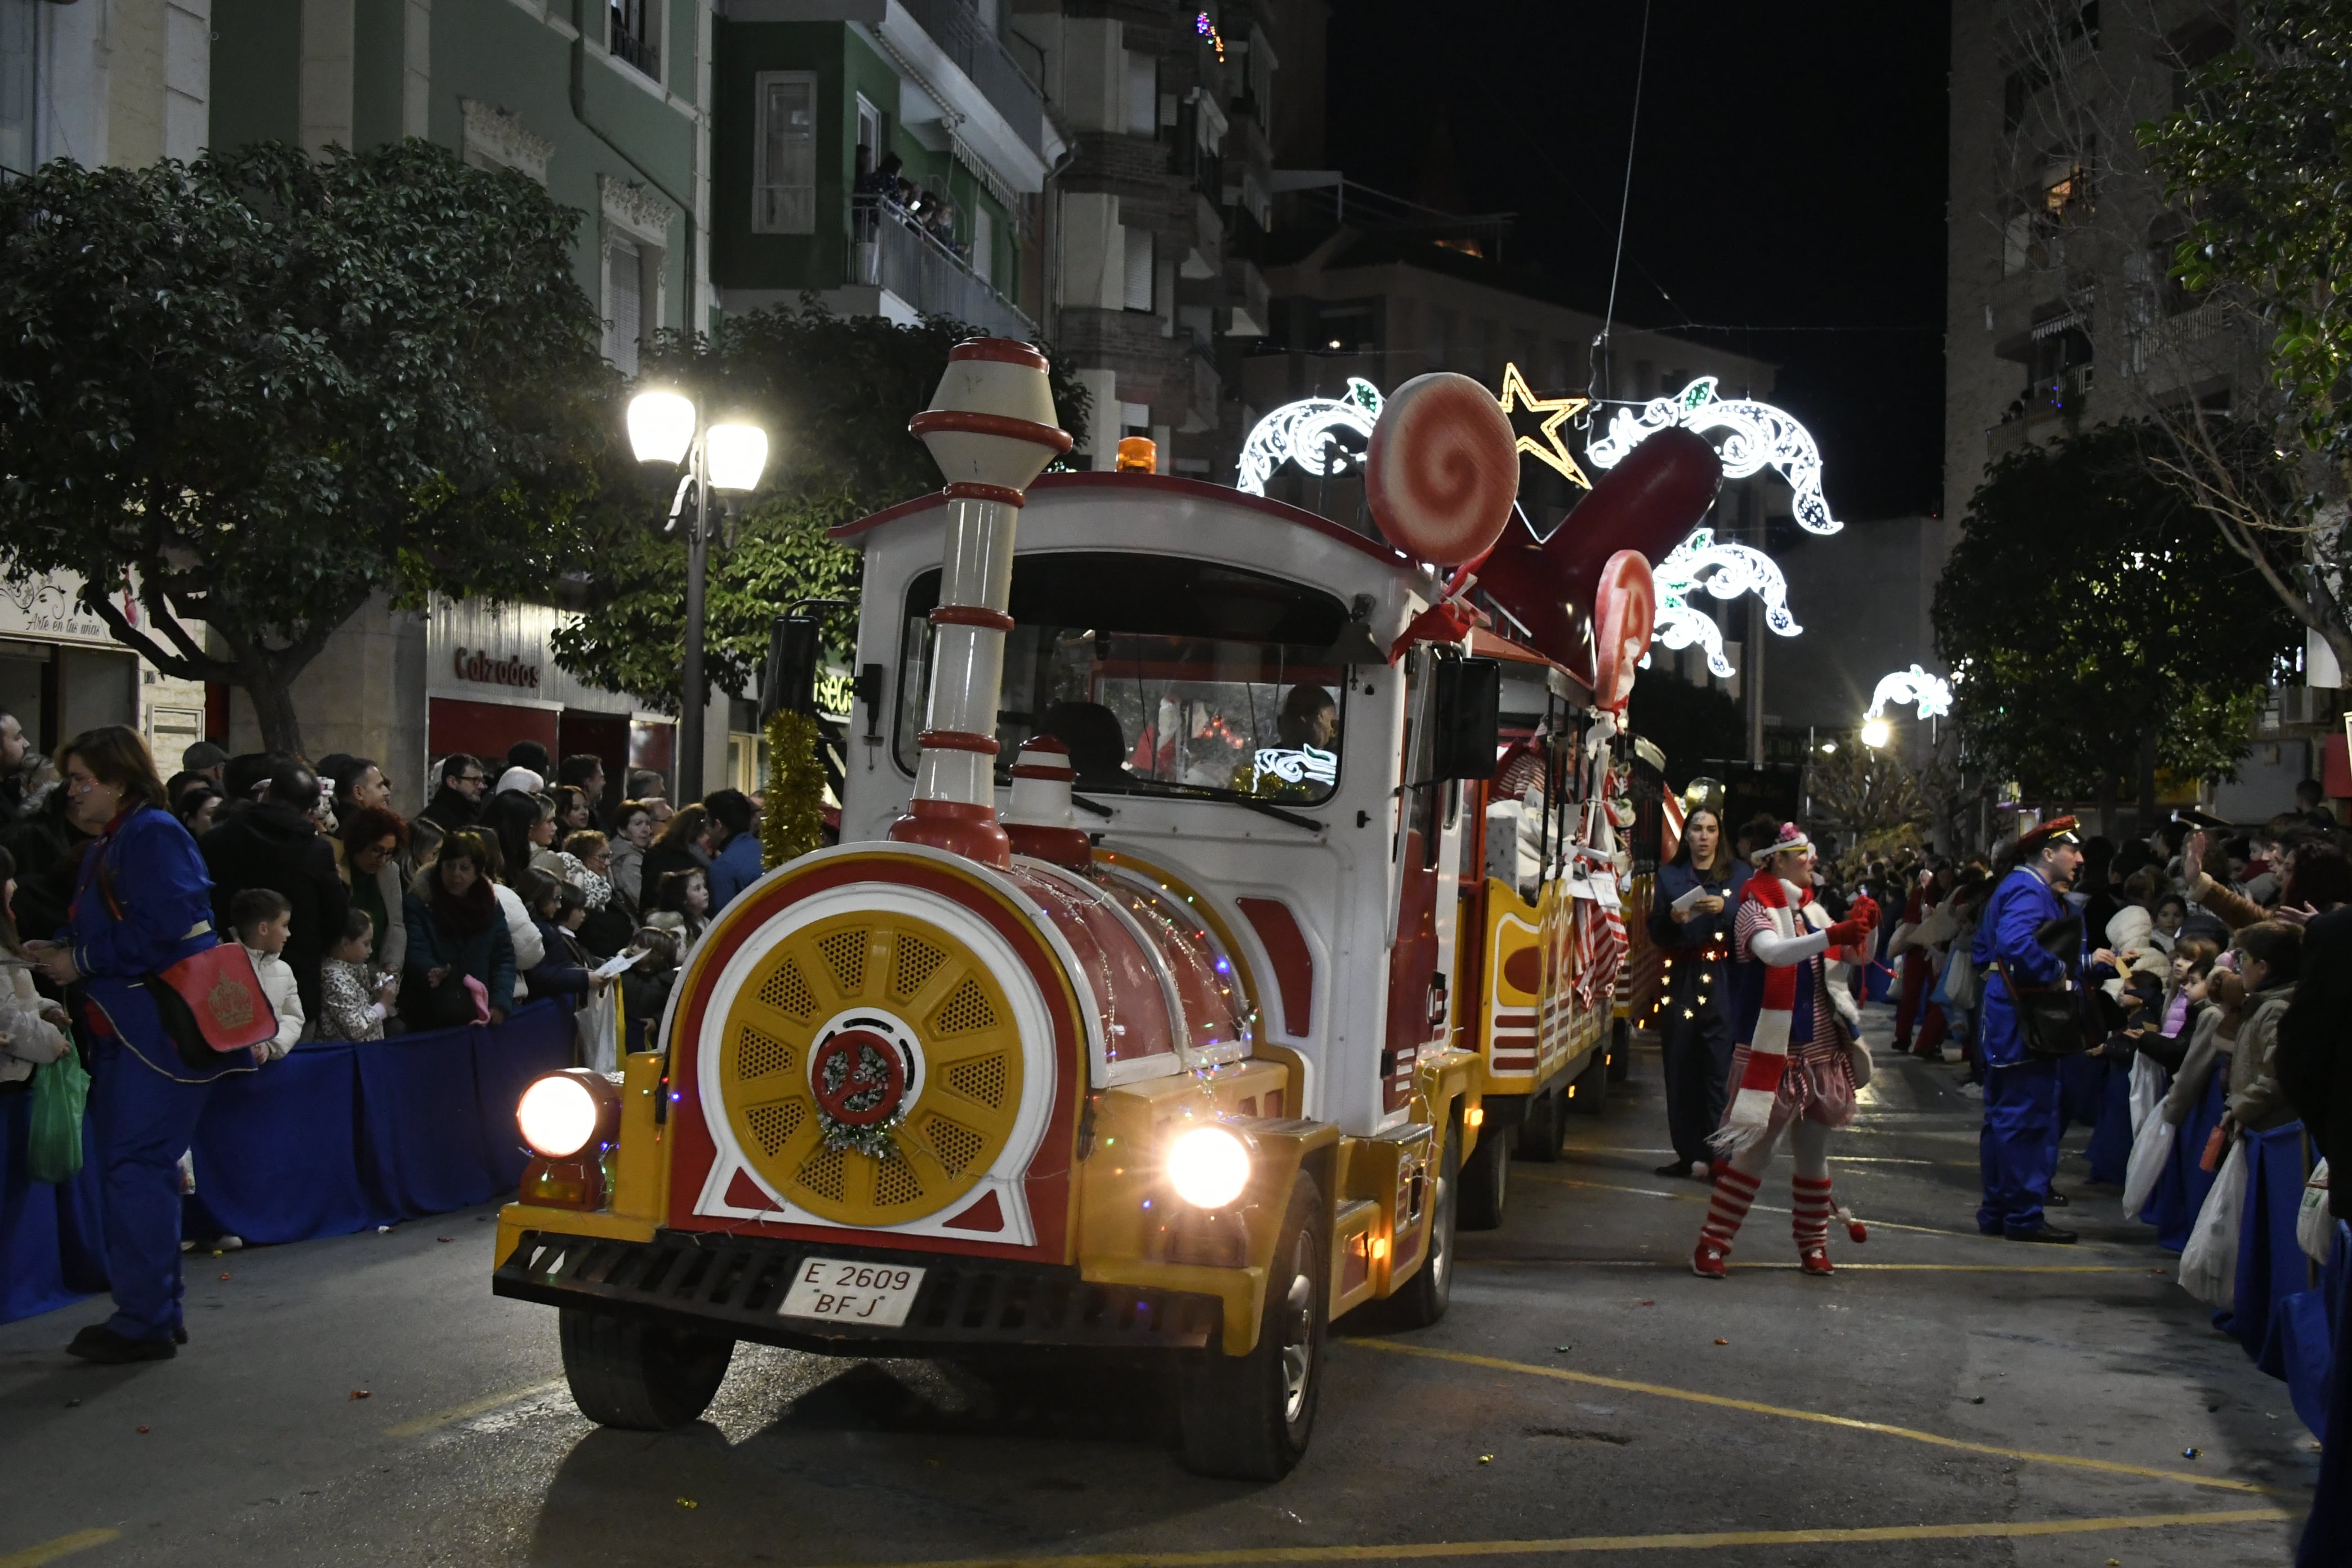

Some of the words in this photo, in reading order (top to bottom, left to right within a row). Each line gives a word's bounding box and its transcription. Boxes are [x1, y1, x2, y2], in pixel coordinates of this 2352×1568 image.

[26, 613, 49, 630] Arte
[52, 620, 63, 632] en
[66, 618, 77, 633] tus
[455, 647, 539, 688] Calzados
[804, 1263, 826, 1283] E
[836, 1266, 910, 1290] 2609
[814, 1294, 877, 1317] BFJ
